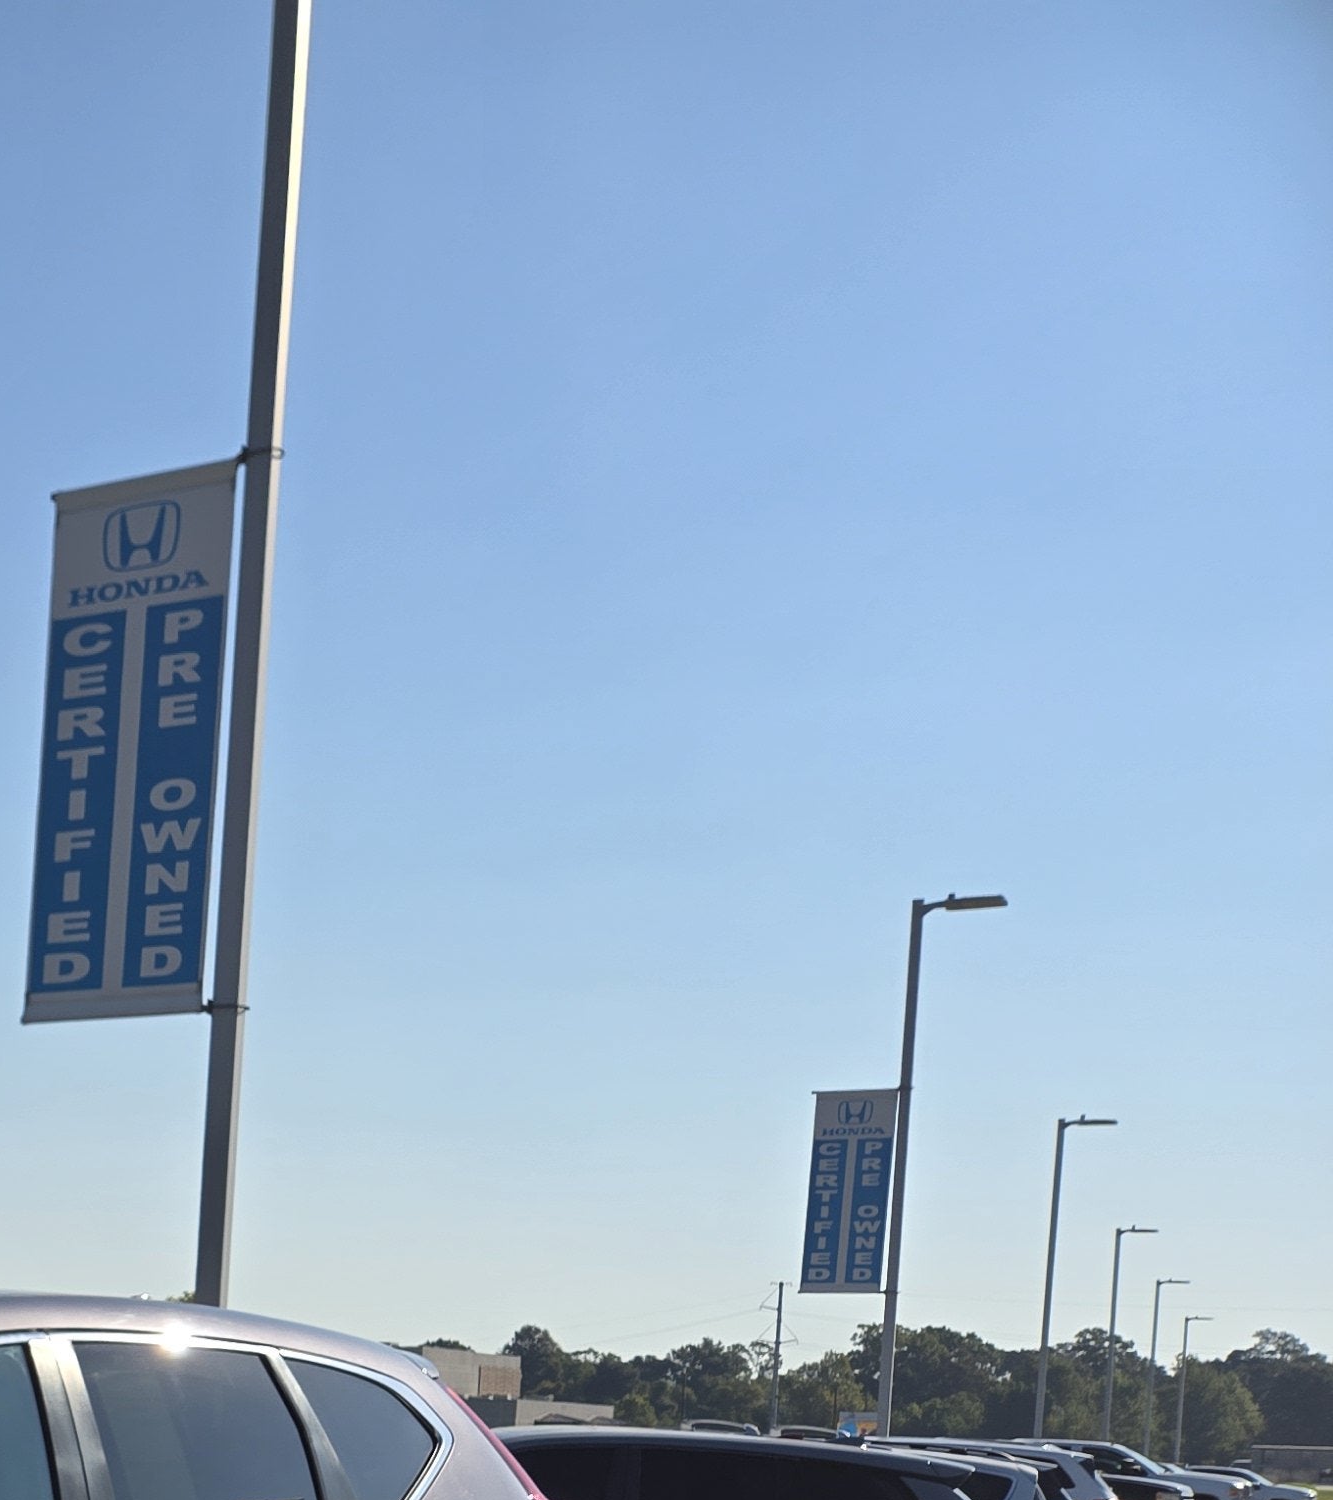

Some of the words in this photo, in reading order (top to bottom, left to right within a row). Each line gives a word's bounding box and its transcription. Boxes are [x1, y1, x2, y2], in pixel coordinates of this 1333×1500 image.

[68, 569, 209, 607] HONDA
[157, 608, 204, 729] PRE
[42, 622, 113, 986] CERTIFIED
[139, 778, 202, 979] OWNED
[822, 1127, 885, 1137] HONDA
[861, 1141, 883, 1187] PRE
[807, 1142, 842, 1281] CERTIFIED
[852, 1205, 881, 1281] OWNED
